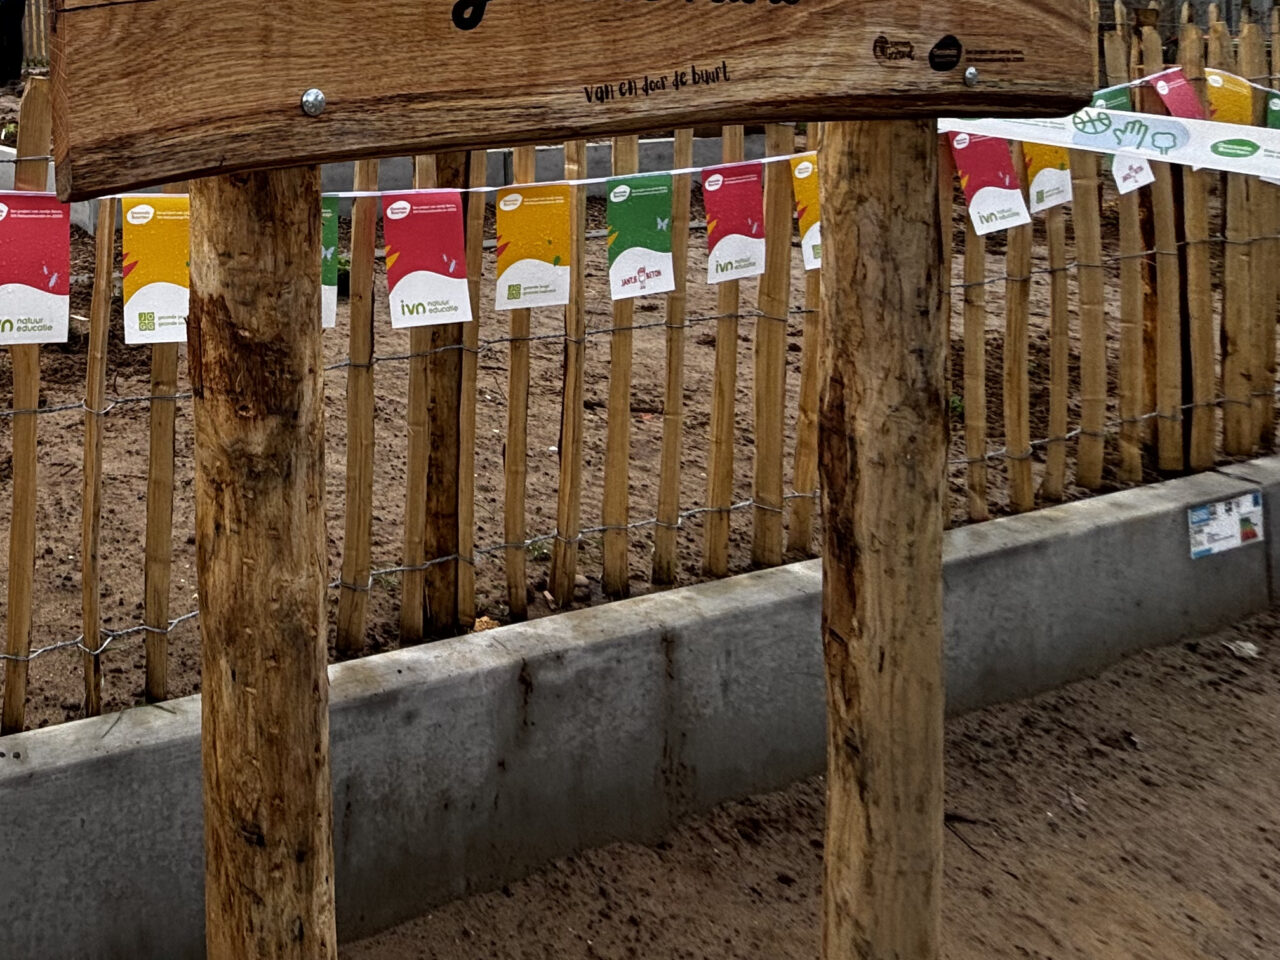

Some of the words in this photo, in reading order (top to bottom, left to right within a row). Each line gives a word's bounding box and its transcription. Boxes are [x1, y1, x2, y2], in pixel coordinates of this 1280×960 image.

[618, 79, 637, 97] en
[642, 75, 668, 96] door
[672, 70, 688, 90] de
[691, 60, 731, 85] buurt
[716, 260, 733, 273] ivn
[400, 299, 426, 316] ivn
[16, 324, 53, 332] educatie
